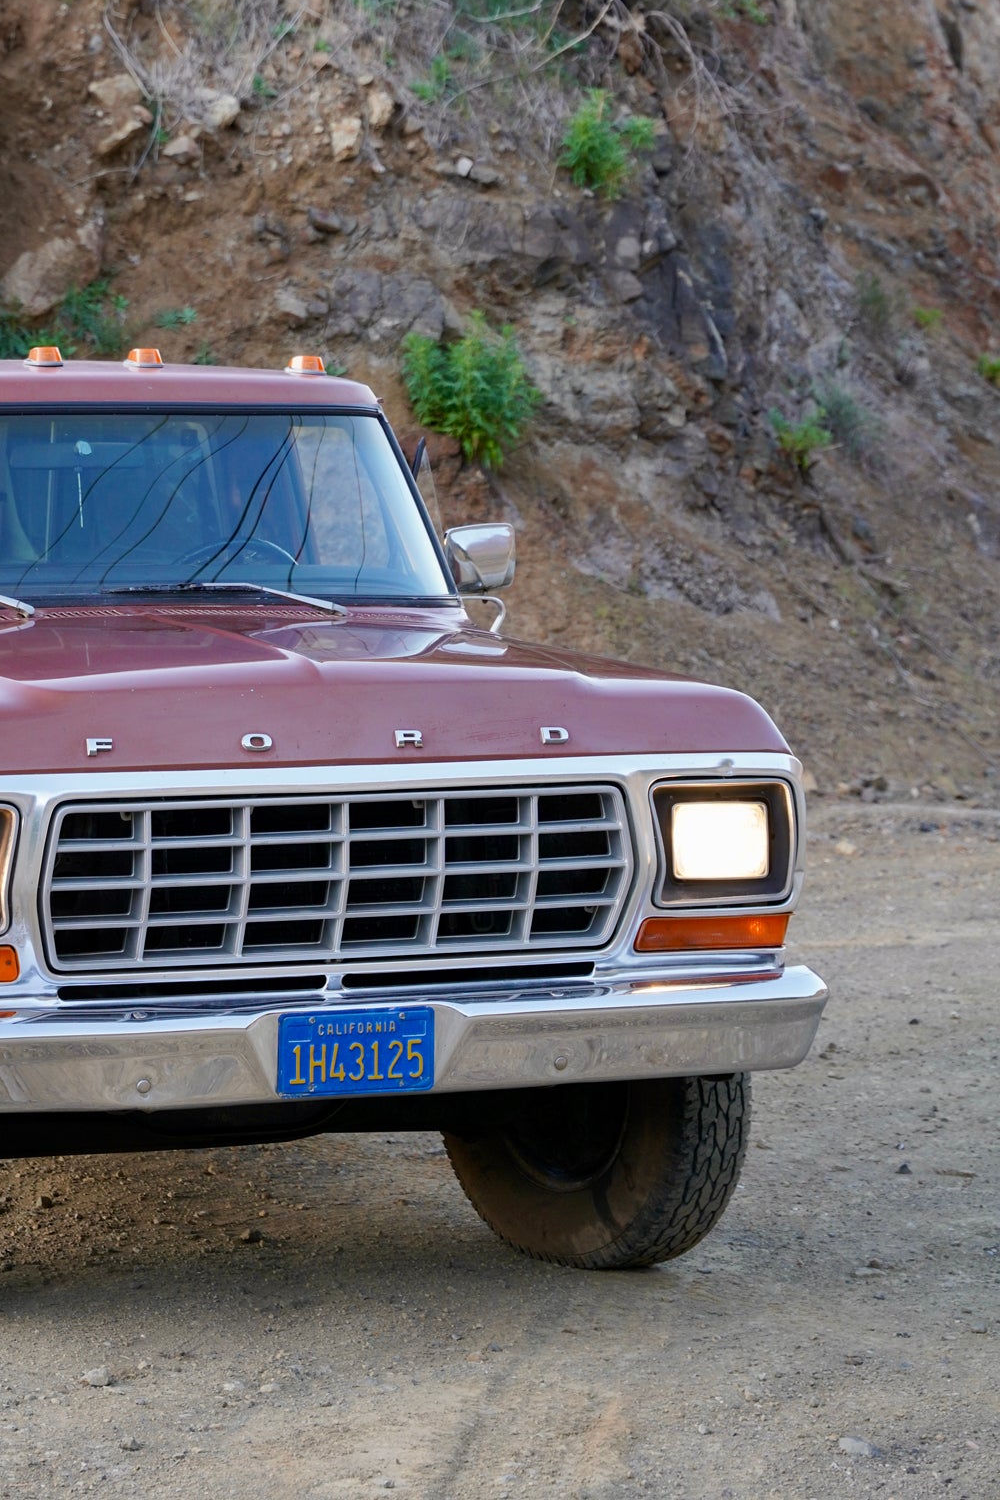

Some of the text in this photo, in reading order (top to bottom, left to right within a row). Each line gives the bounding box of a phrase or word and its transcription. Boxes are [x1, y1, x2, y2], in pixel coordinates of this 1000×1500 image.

[86, 727, 569, 757] FORD
[318, 1022, 396, 1036] CALIFORNIA
[290, 1040, 424, 1084] 1H43125
